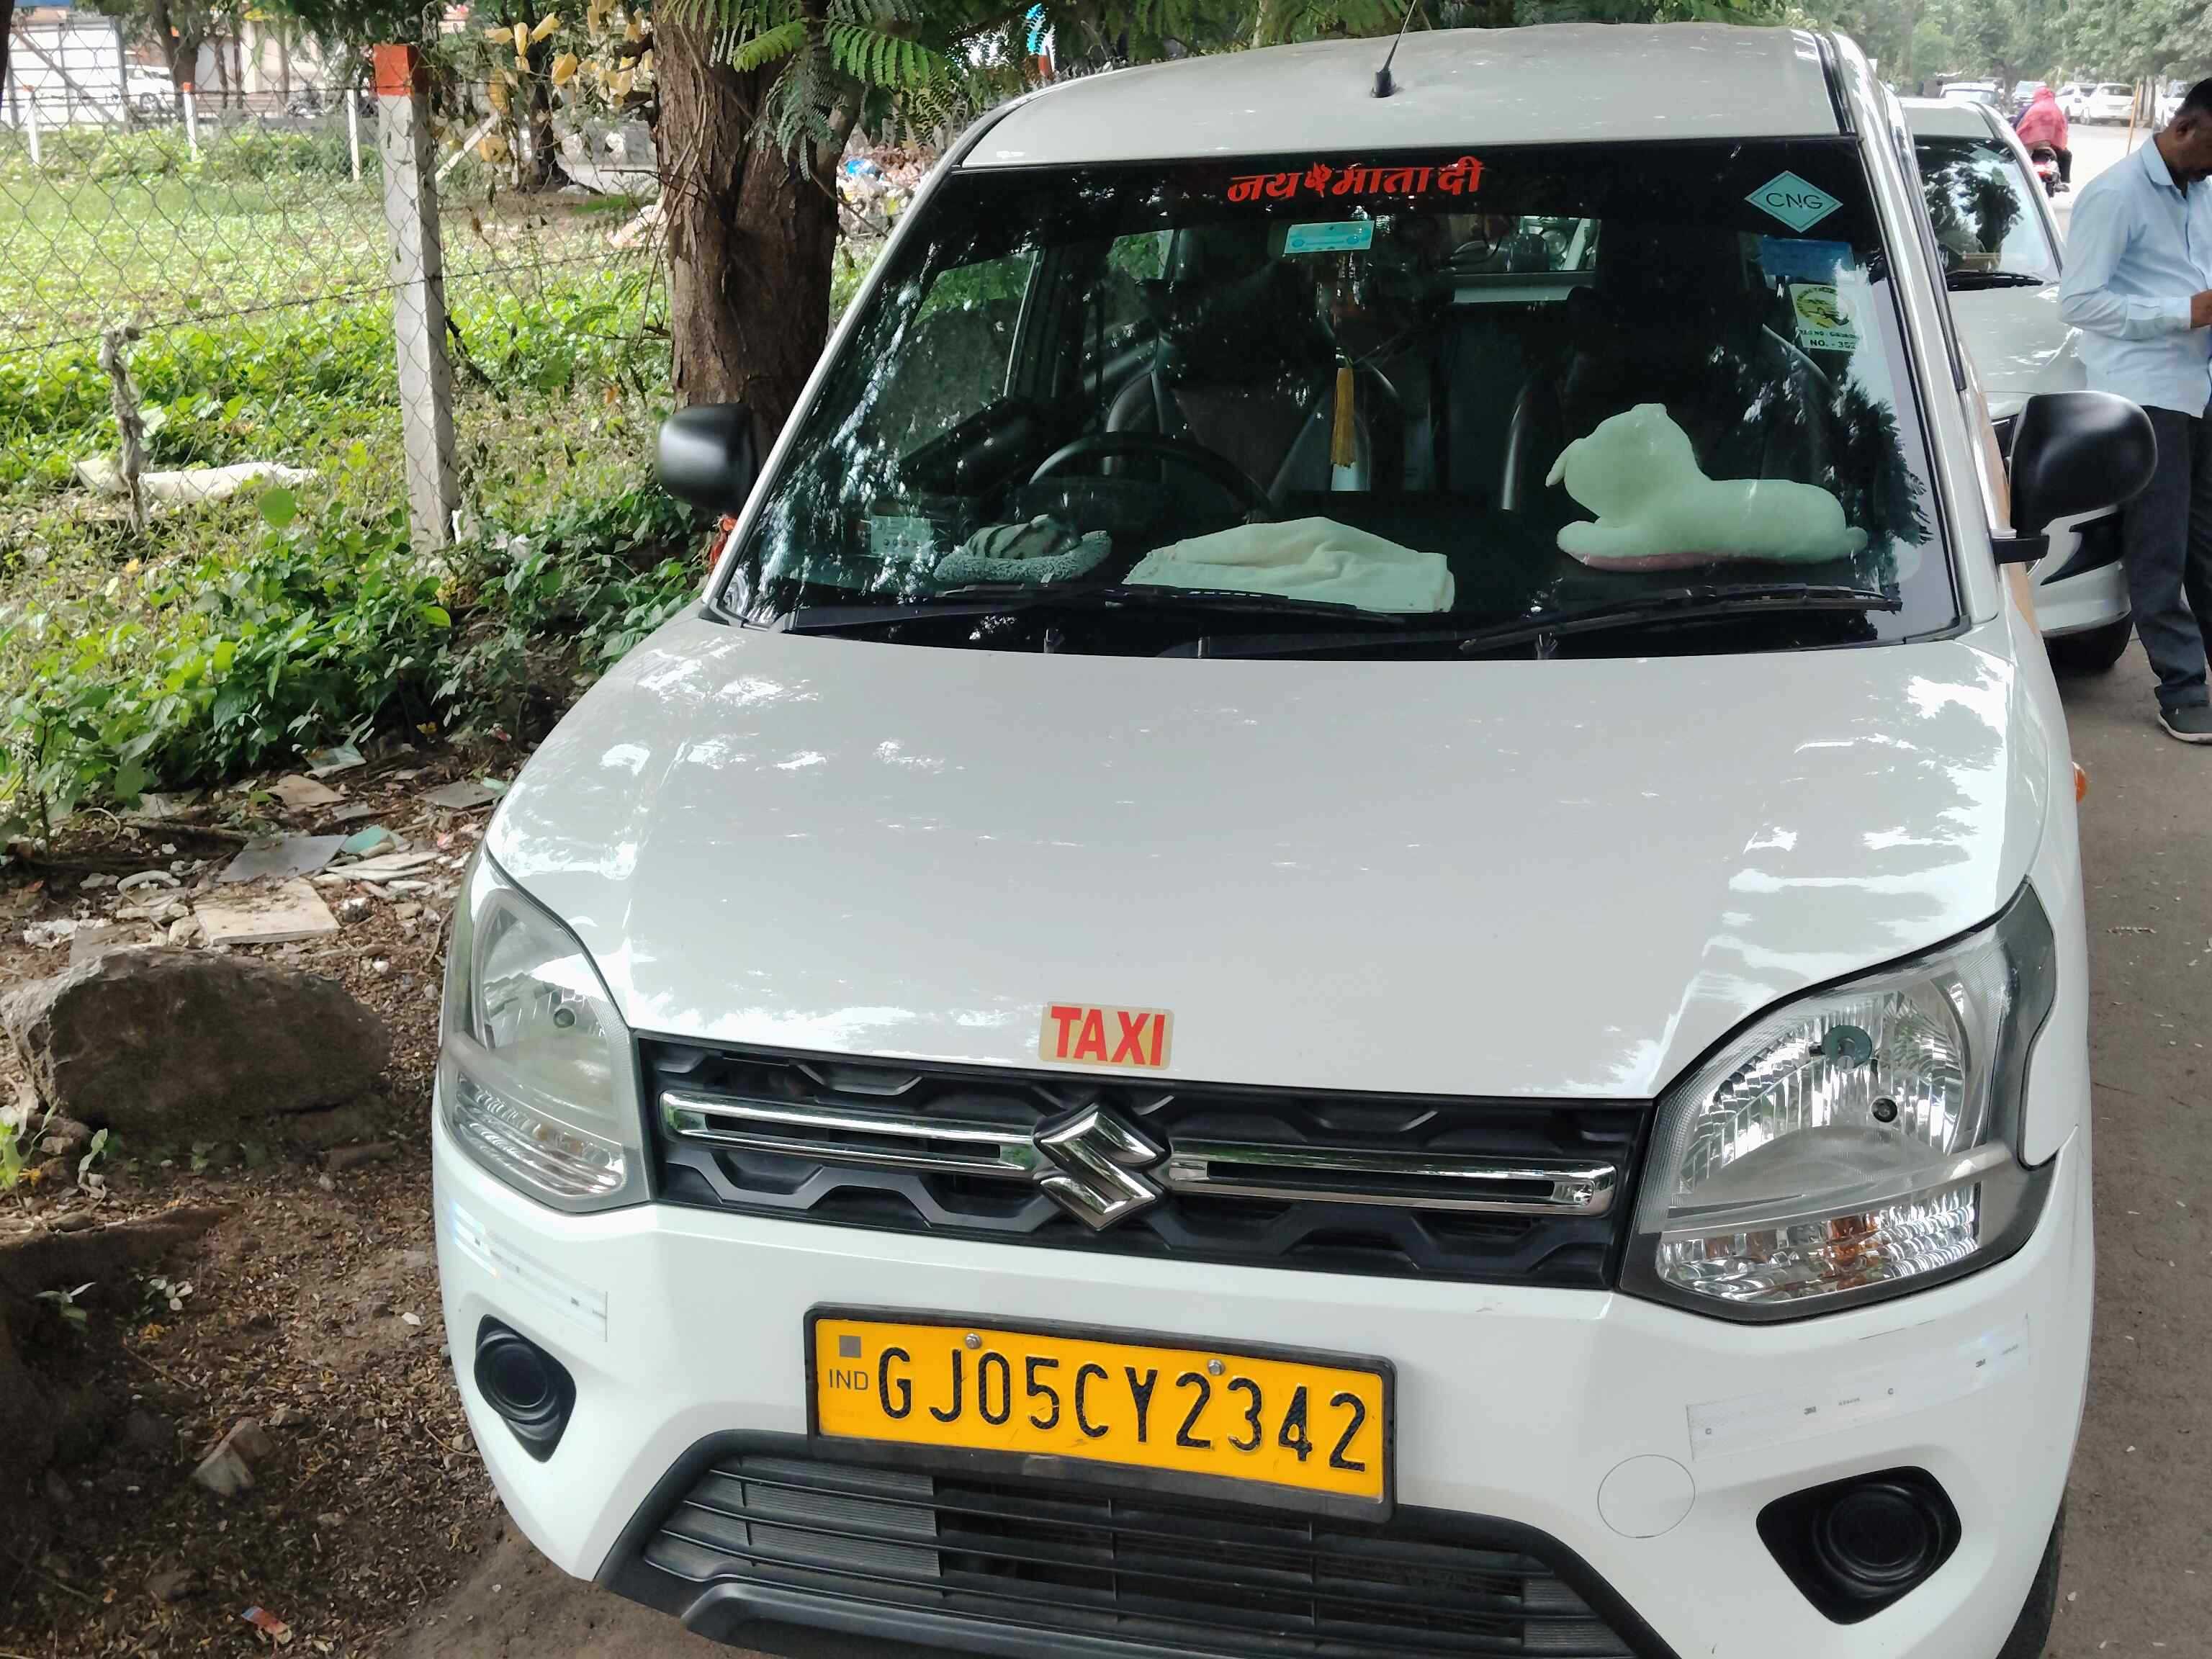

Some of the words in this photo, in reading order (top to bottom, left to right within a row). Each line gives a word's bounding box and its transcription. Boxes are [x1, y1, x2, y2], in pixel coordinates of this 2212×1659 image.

[1227, 171, 1302, 203] जय
[1331, 166, 1431, 194] माता
[1437, 155, 1485, 196] दी
[1766, 192, 1823, 209] CNG
[1051, 1005, 1166, 1066] TAXI
[829, 1368, 868, 1390] IND
[878, 1346, 1367, 1472] GJ05CY2342
